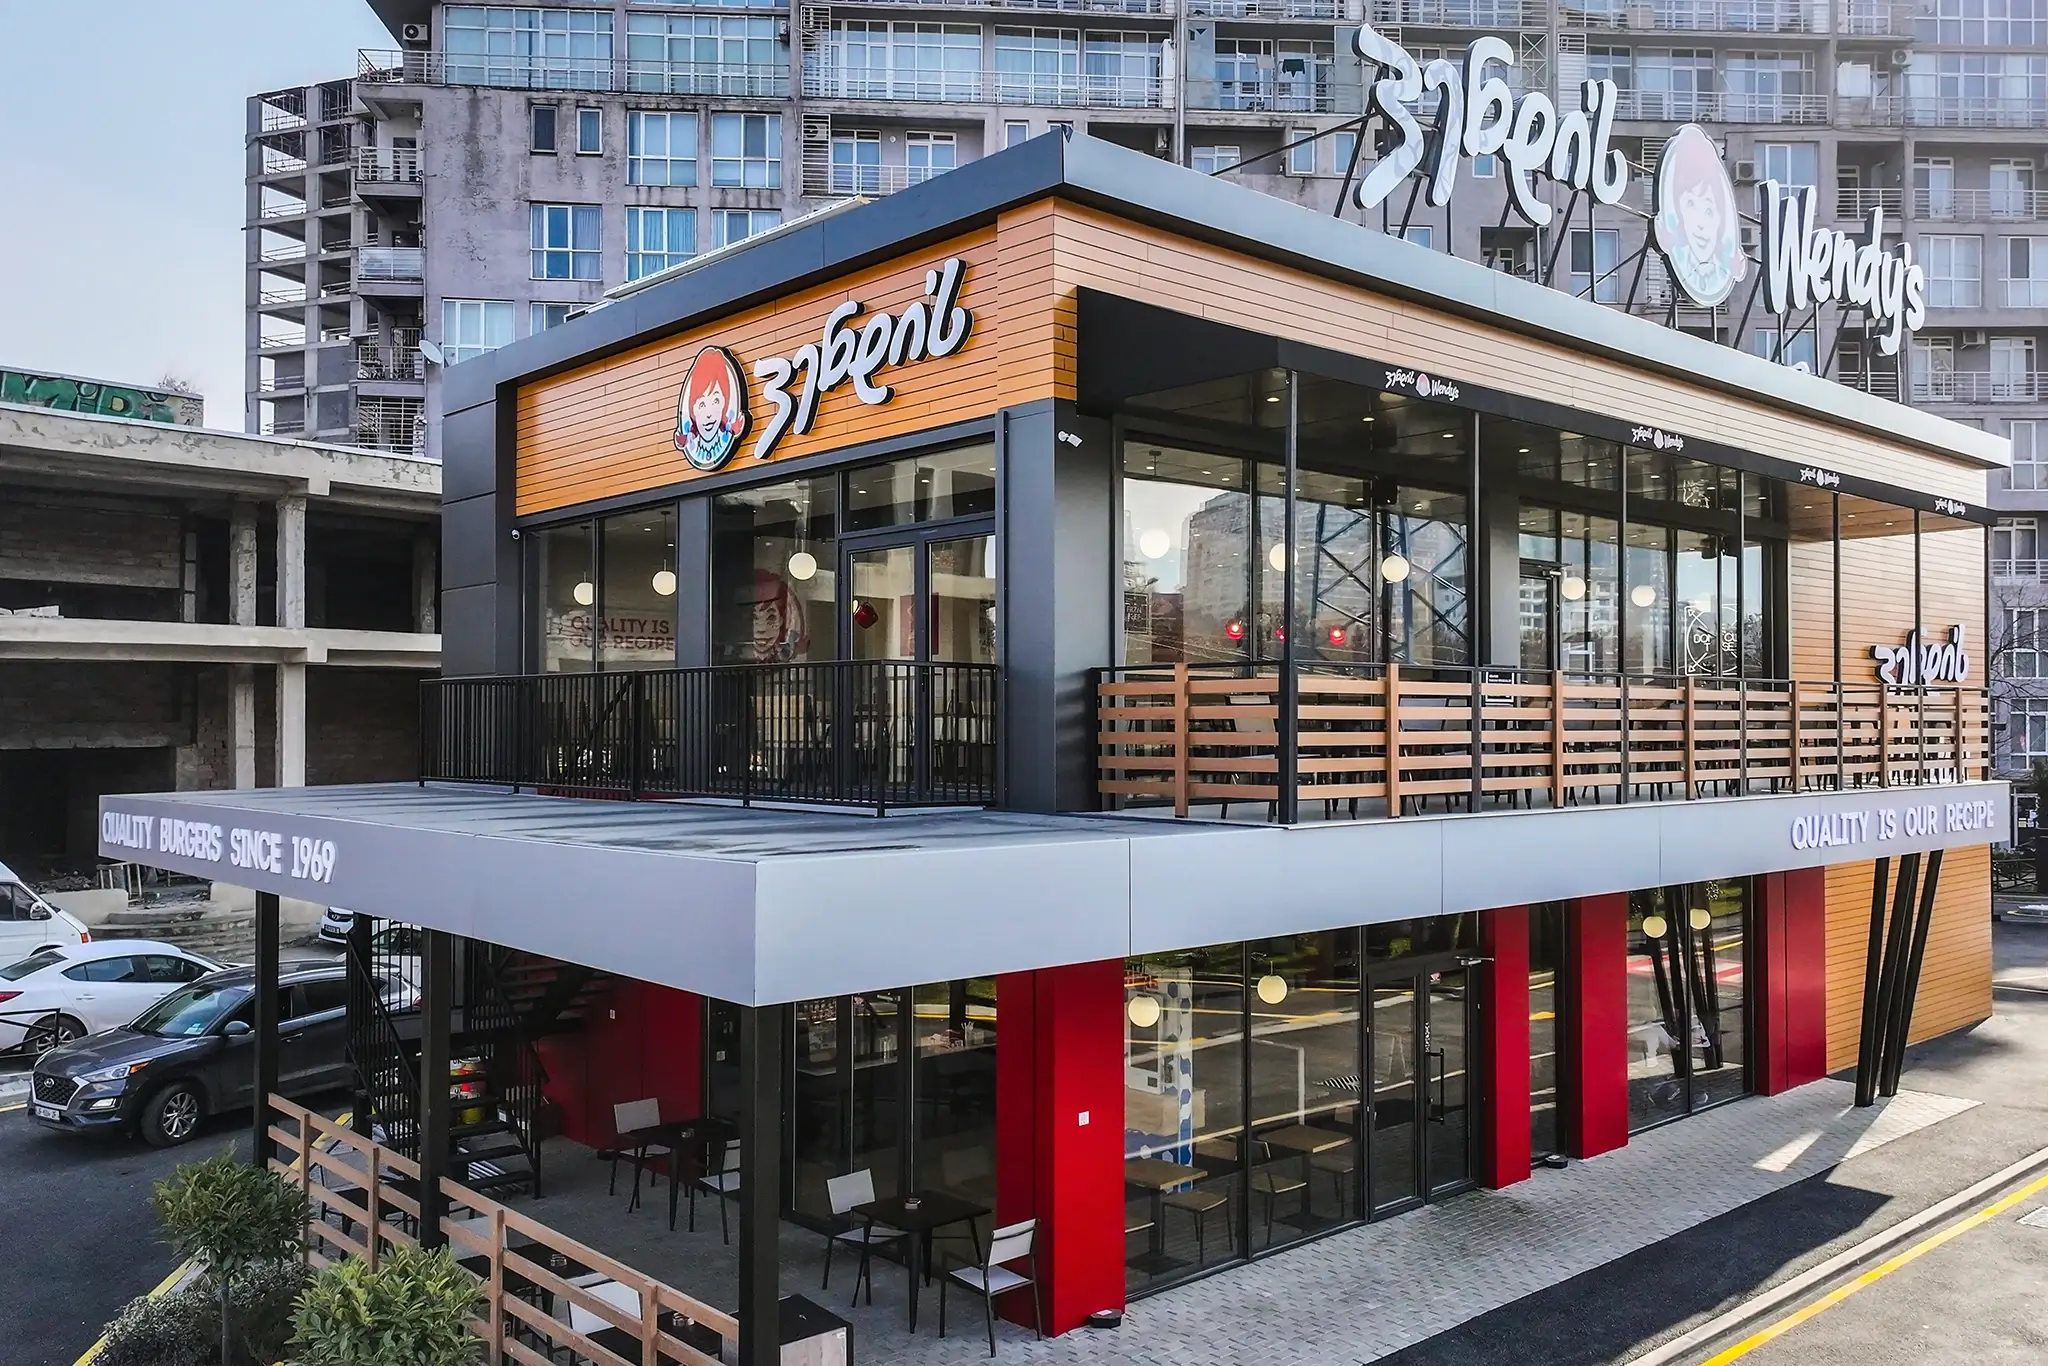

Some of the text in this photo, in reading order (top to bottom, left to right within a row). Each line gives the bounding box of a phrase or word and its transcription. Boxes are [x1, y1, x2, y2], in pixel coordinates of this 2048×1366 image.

[1759, 178, 1925, 356] Wendy's
[651, 620, 669, 634] IS
[102, 811, 338, 884] QUALITY BURGERS SINCE 1969
[1791, 800, 1995, 850] QUALITY IS OUR RECIPE
